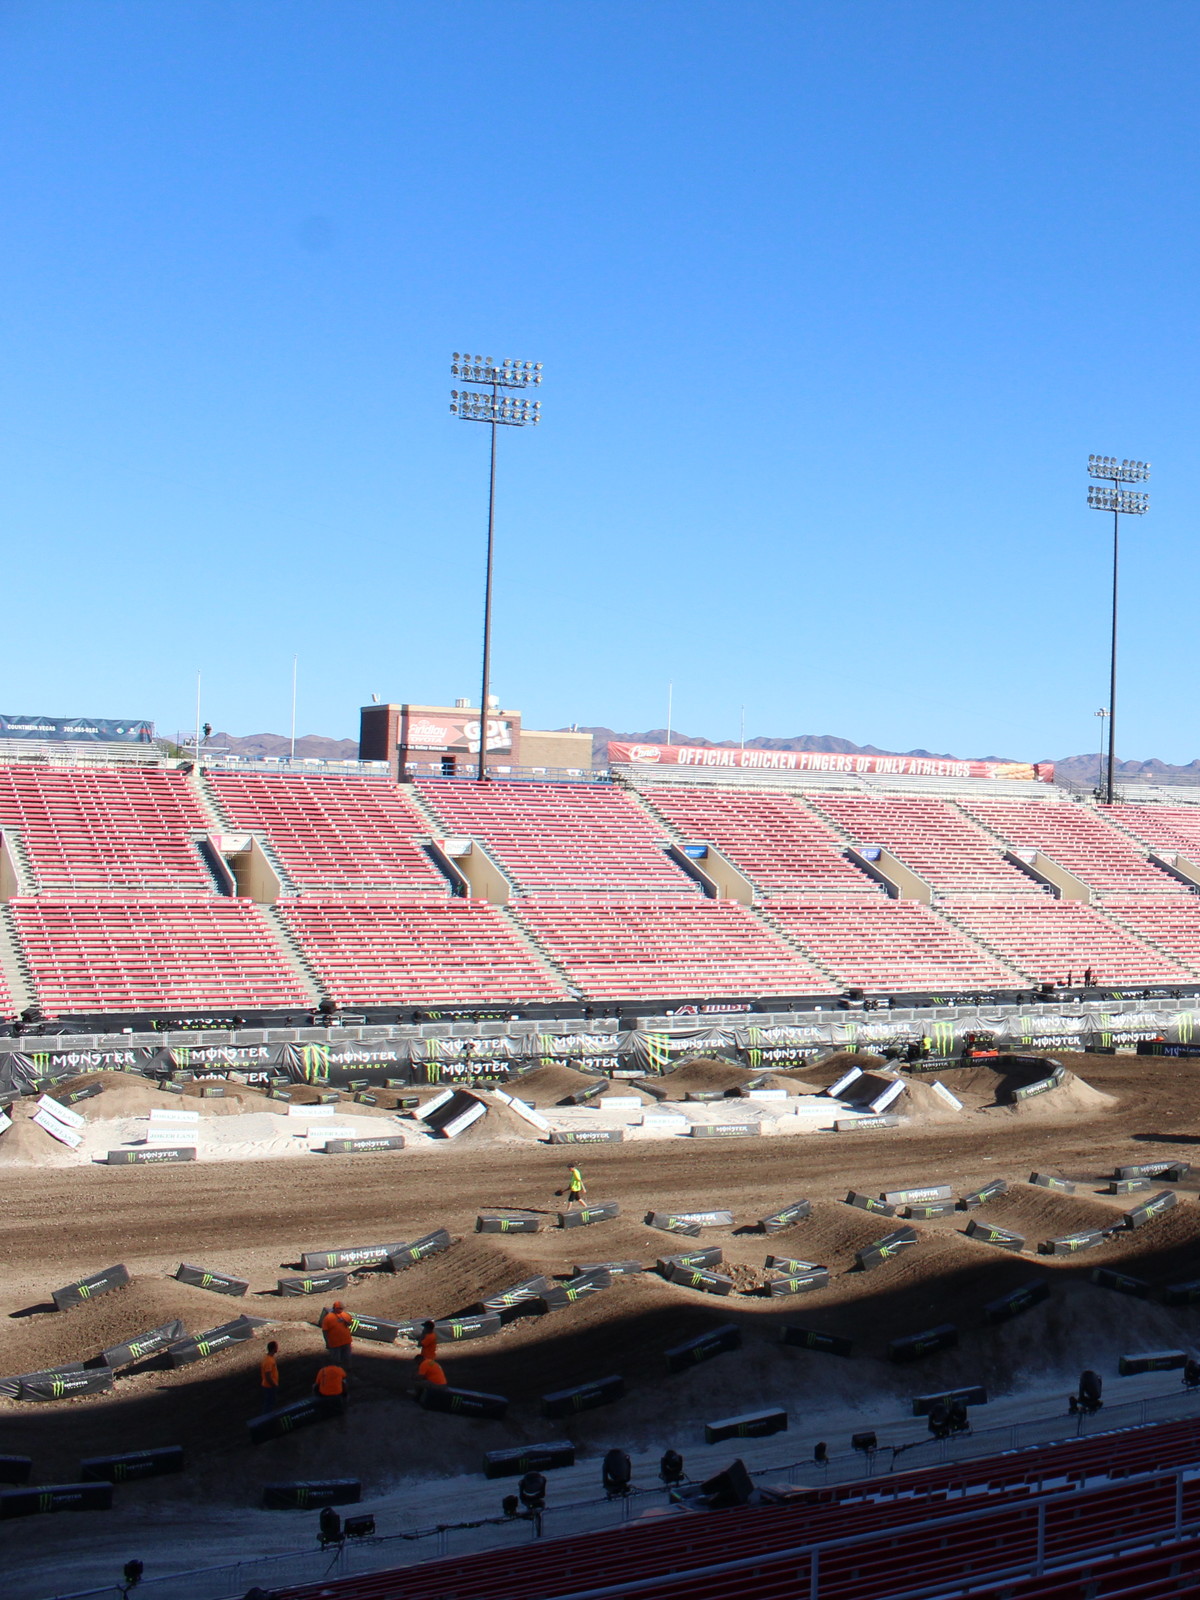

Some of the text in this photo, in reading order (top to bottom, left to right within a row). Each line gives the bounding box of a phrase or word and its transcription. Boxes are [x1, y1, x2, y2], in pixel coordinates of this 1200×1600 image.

[678, 749, 736, 767] OFFICIAL
[741, 753, 797, 769] CHICKEN
[800, 755, 852, 772] FINGERS
[856, 757, 871, 772] OF
[876, 759, 906, 774] UNLV
[908, 760, 971, 777] ATHLETICS
[1032, 1016, 1081, 1027] MONSTER
[1111, 1014, 1157, 1024] MONSTER
[762, 1027, 820, 1039] MONSTER
[856, 1024, 911, 1034] MONSTER
[555, 1034, 619, 1046] MONSTER
[1032, 1036, 1081, 1047] MONSTER
[1112, 1032, 1157, 1043] MONSTER
[671, 1038, 726, 1050] MONSTER
[52, 1052, 137, 1067] MONSTER
[192, 1047, 270, 1061] MONSTER
[332, 1051, 397, 1064] MONSTER
[576, 1132, 609, 1140] MONSTER
[354, 1140, 390, 1148] MONSTER
[138, 1149, 179, 1159] MONSTER
[341, 1248, 388, 1262] MONSTER
